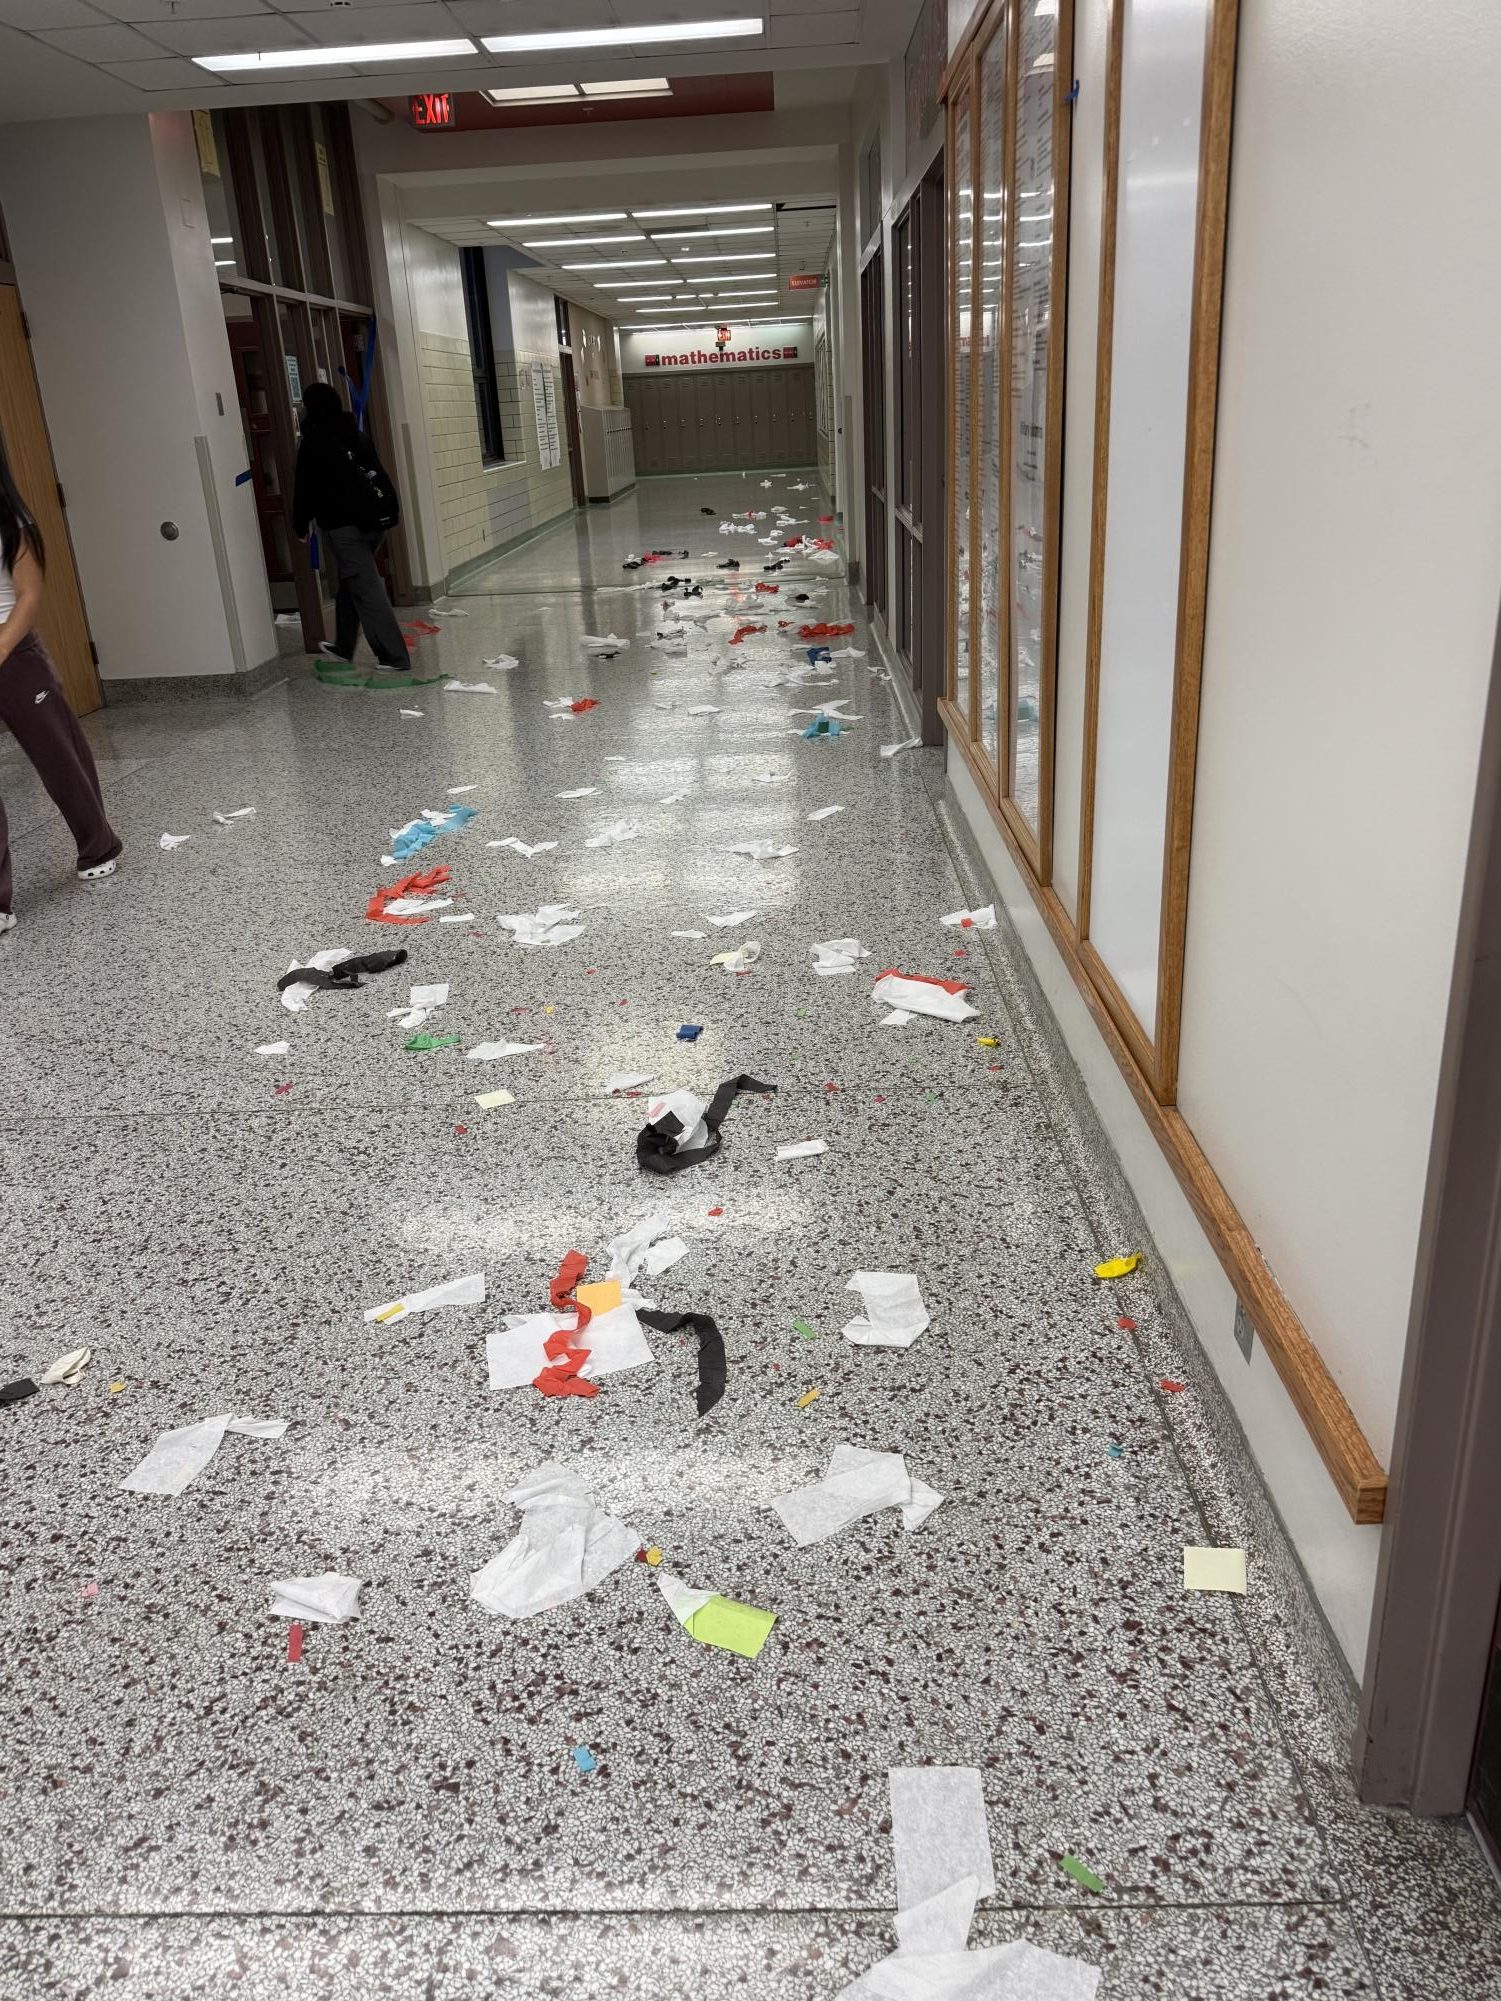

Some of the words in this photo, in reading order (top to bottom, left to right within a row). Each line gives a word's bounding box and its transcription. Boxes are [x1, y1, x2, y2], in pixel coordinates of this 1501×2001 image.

[413, 93, 449, 124] EXIT
[791, 279, 817, 287] ELEVATOR
[661, 347, 782, 366] mathematics
